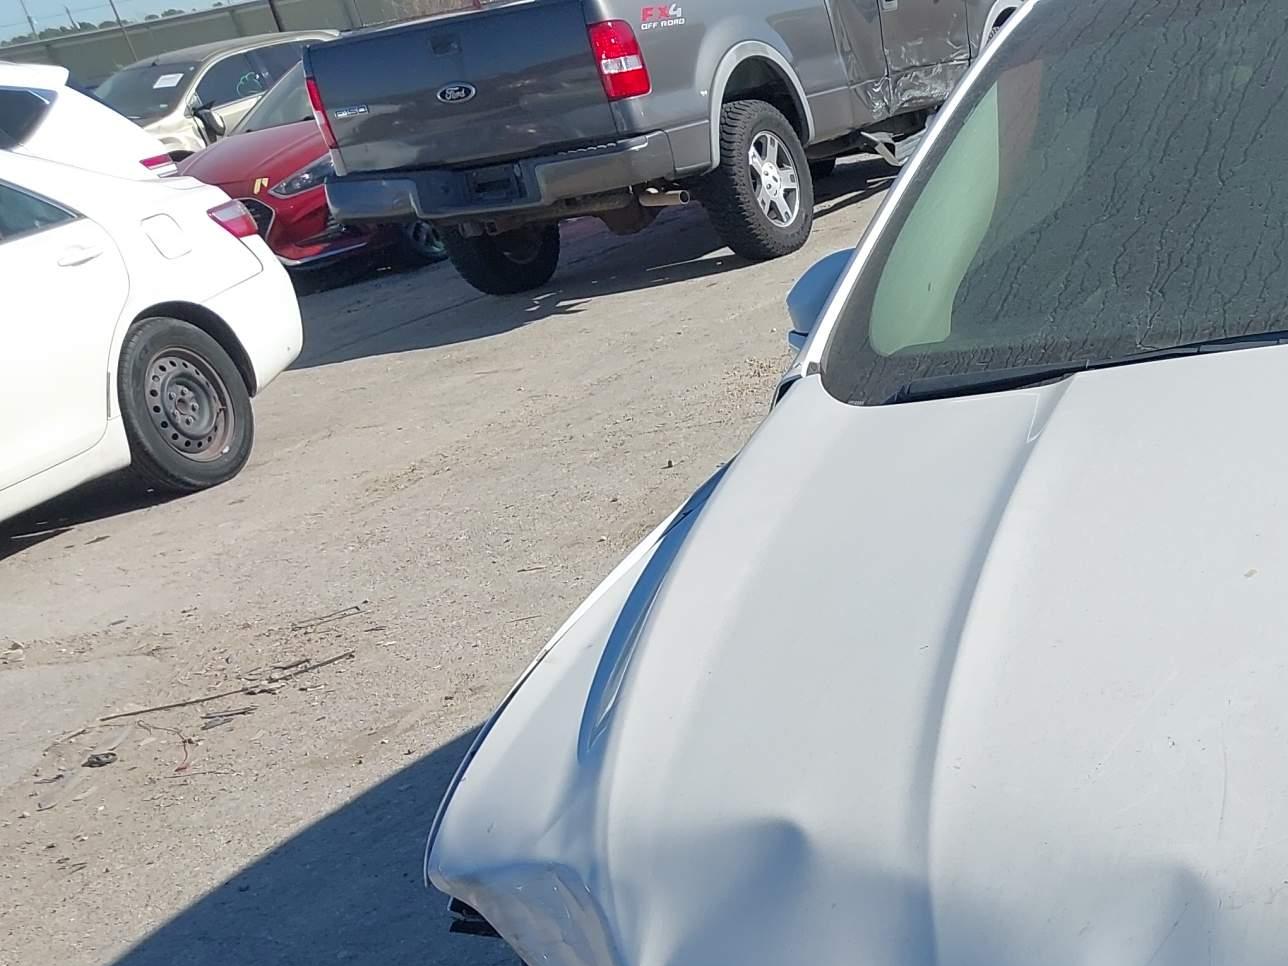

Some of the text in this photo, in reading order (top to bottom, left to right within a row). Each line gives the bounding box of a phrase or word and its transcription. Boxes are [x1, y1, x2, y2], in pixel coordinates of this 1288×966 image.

[641, 3, 682, 21] FX4
[641, 18, 686, 30] OFF ROAD
